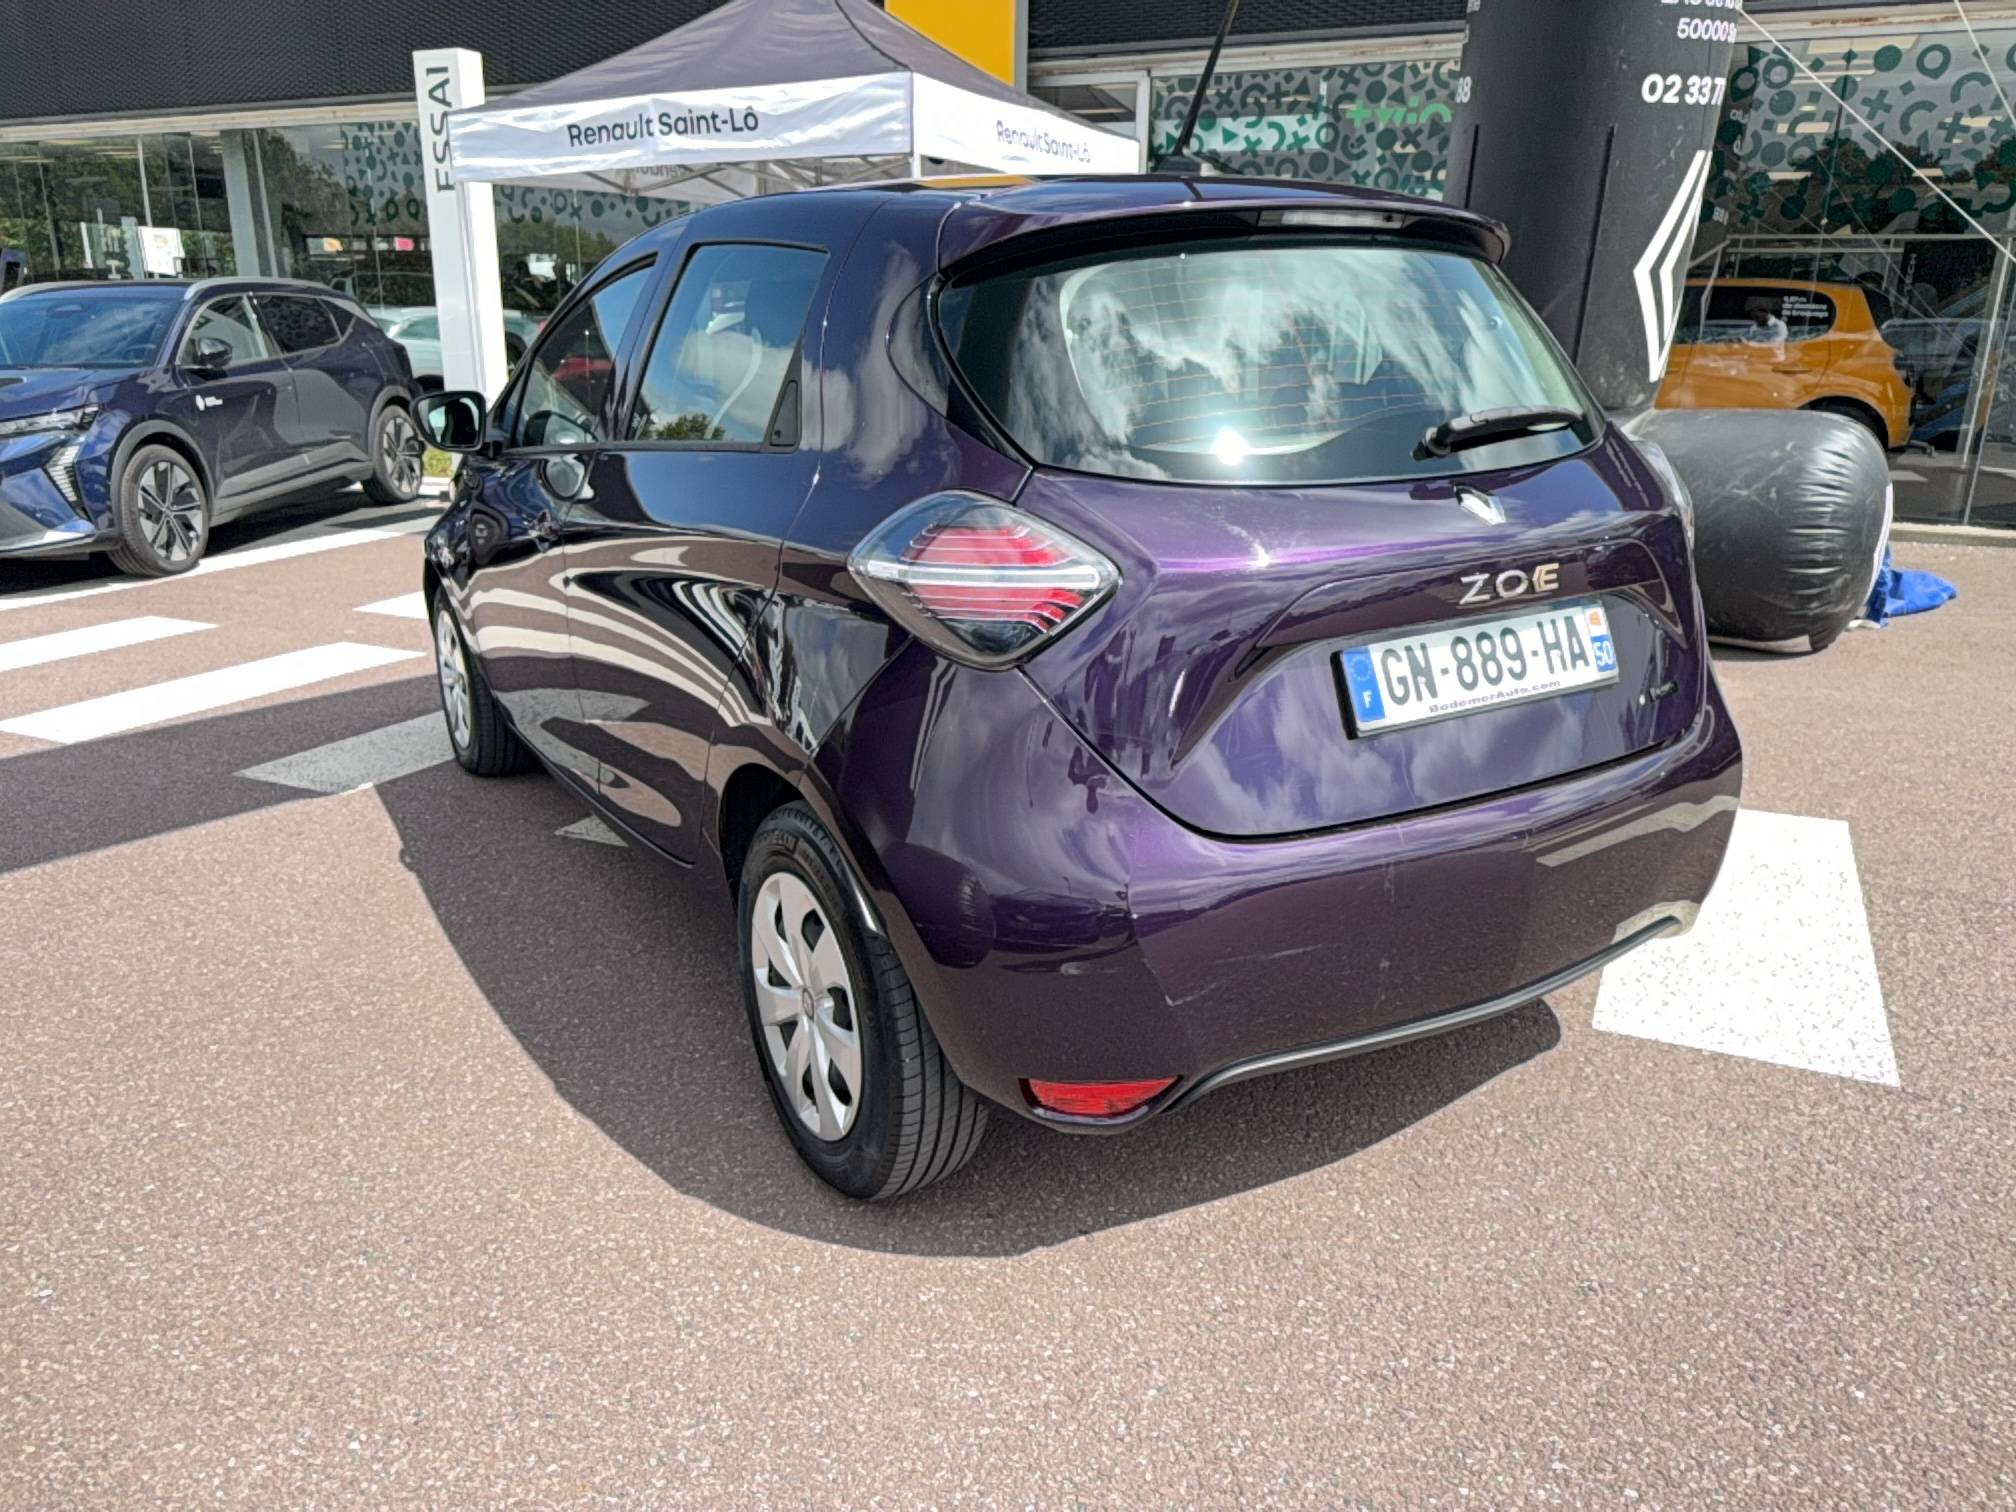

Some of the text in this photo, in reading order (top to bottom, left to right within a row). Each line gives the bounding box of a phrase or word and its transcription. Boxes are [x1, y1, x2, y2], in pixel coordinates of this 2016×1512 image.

[1641, 73, 1682, 104] 02
[425, 65, 456, 193] ESSAI
[567, 105, 759, 148] Renault Saint-Lô
[996, 119, 1042, 152] Renault
[1459, 562, 1559, 605] ZOE
[1380, 615, 1590, 707] GN-889-HA
[1592, 640, 1614, 666] 50
[1362, 690, 1372, 709] F
